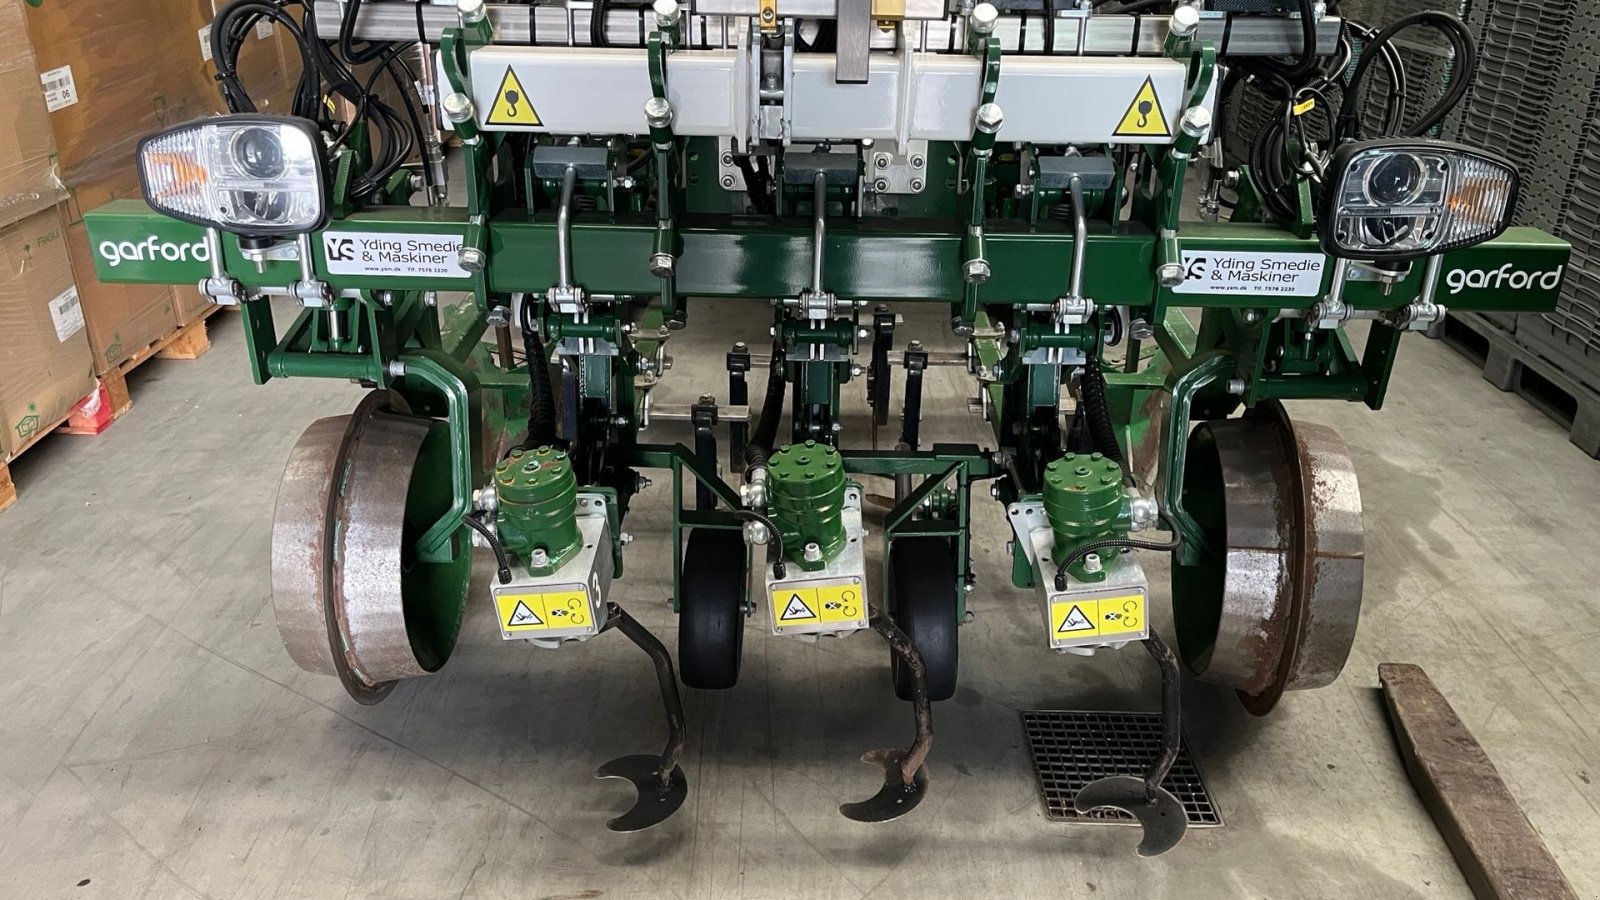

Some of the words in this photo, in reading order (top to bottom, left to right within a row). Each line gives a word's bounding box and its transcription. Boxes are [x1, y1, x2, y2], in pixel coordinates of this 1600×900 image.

[99, 235, 210, 267] garford
[327, 238, 354, 261] YS
[359, 238, 401, 252] Yding
[407, 240, 463, 252] Smedie
[362, 250, 374, 262] &
[378, 251, 448, 264] Maskiner
[1213, 257, 1255, 271] Yding
[1260, 258, 1321, 271] Smedie
[1211, 269, 1223, 281] &
[1228, 270, 1300, 283] Maskiner
[1446, 263, 1563, 294] garford
[592, 571, 602, 609] 3
